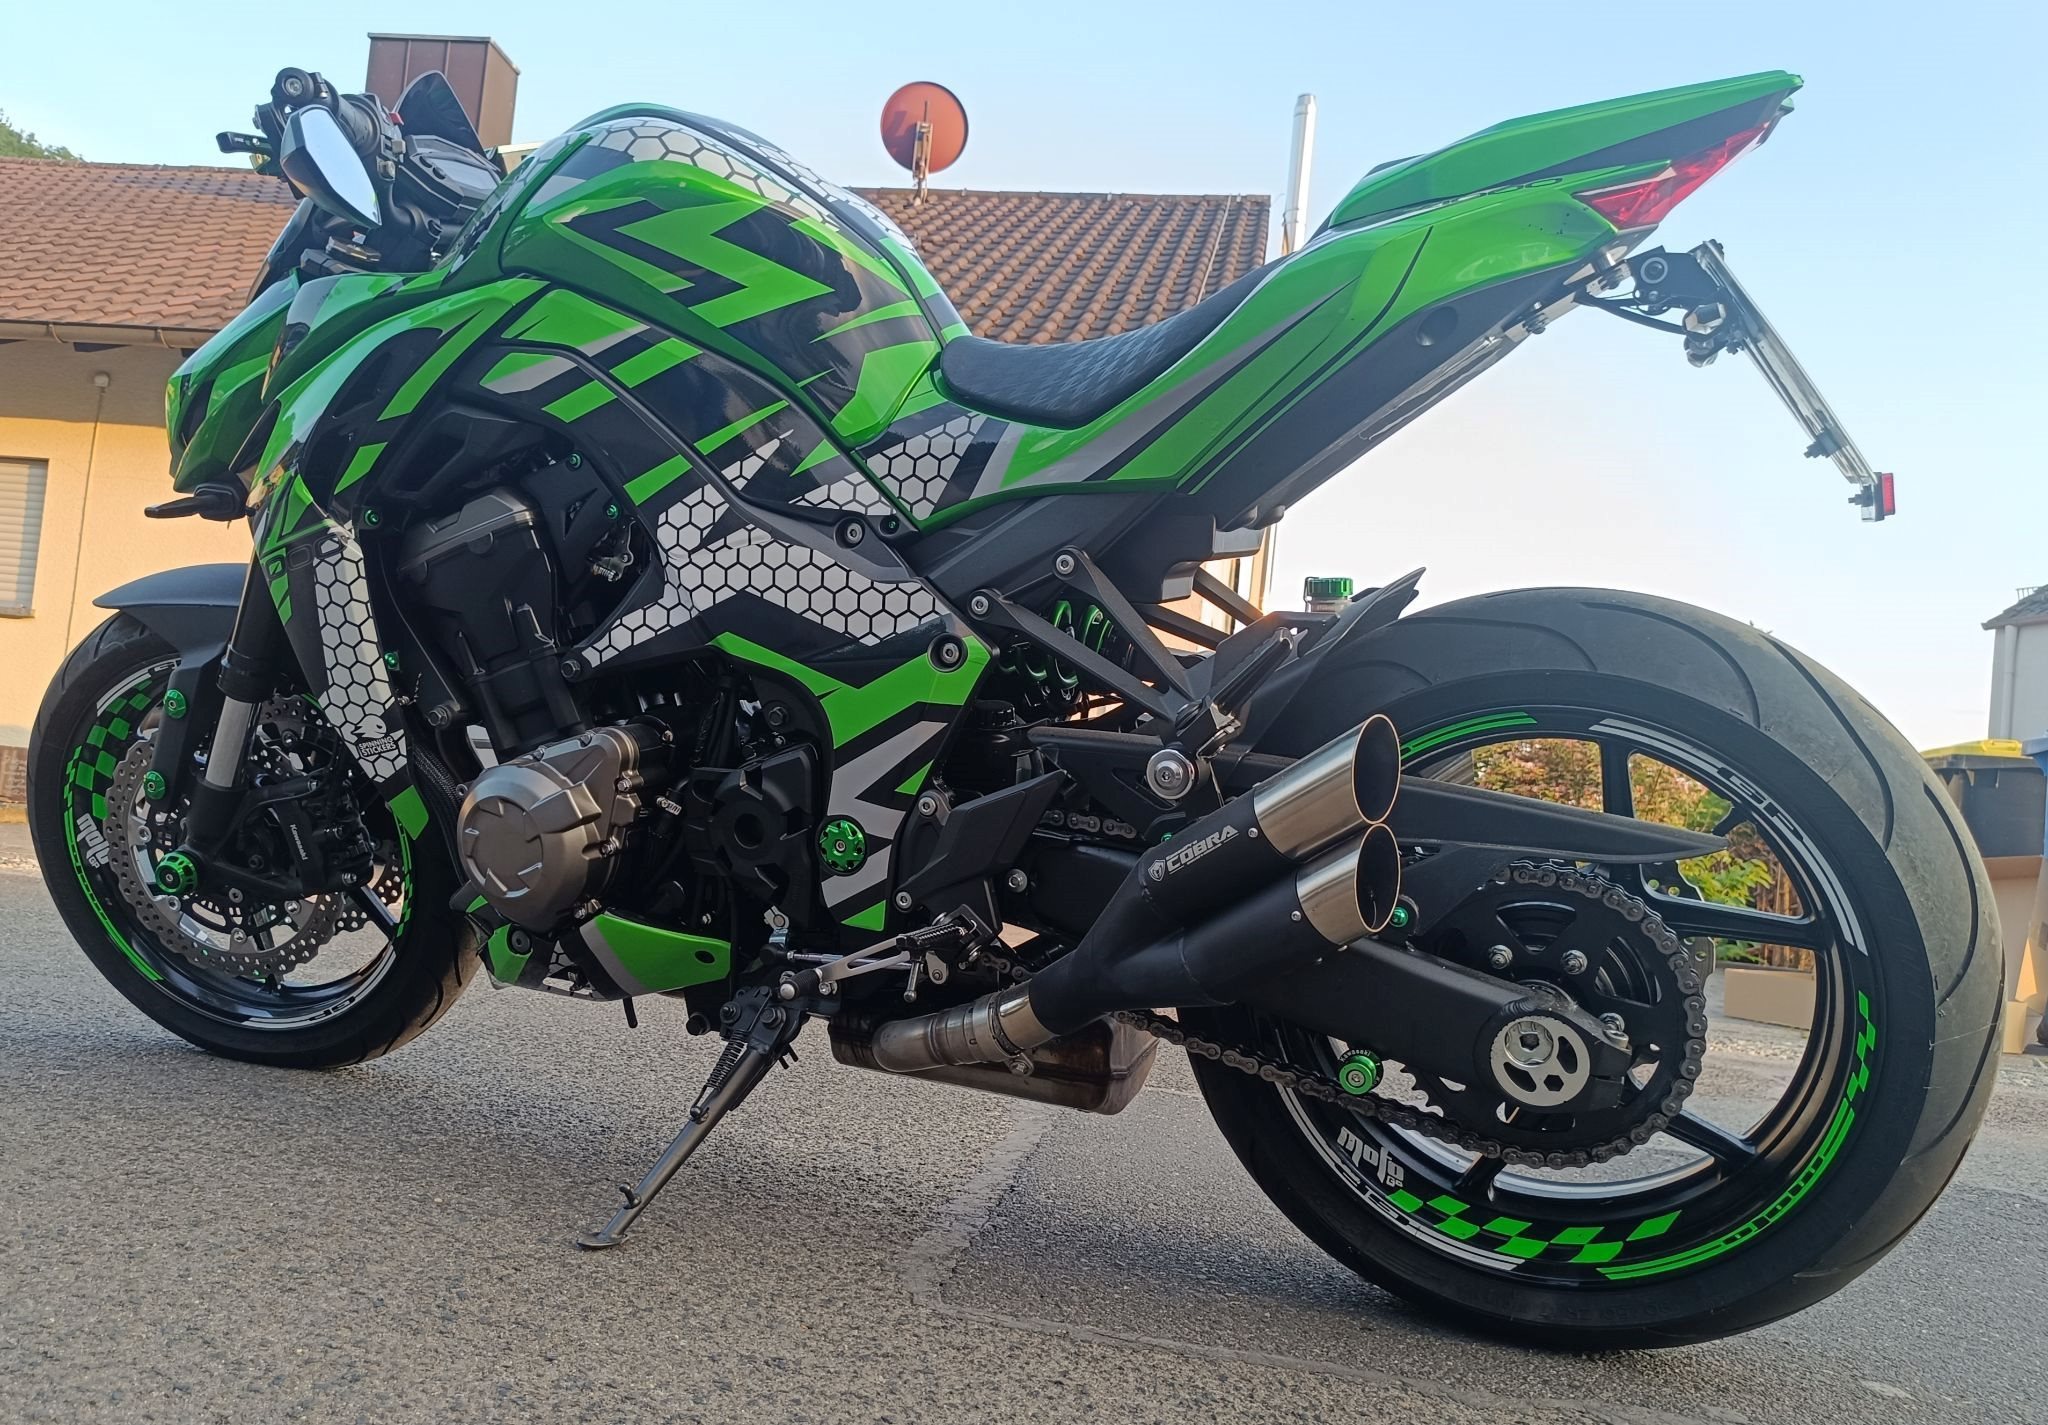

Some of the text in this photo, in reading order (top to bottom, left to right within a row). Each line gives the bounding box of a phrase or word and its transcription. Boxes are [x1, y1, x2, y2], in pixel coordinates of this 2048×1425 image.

[359, 736, 394, 750] SPINNING
[361, 741, 397, 756] STICKERS
[290, 824, 308, 860] Kawasaki
[1166, 825, 1239, 872] COBRA
